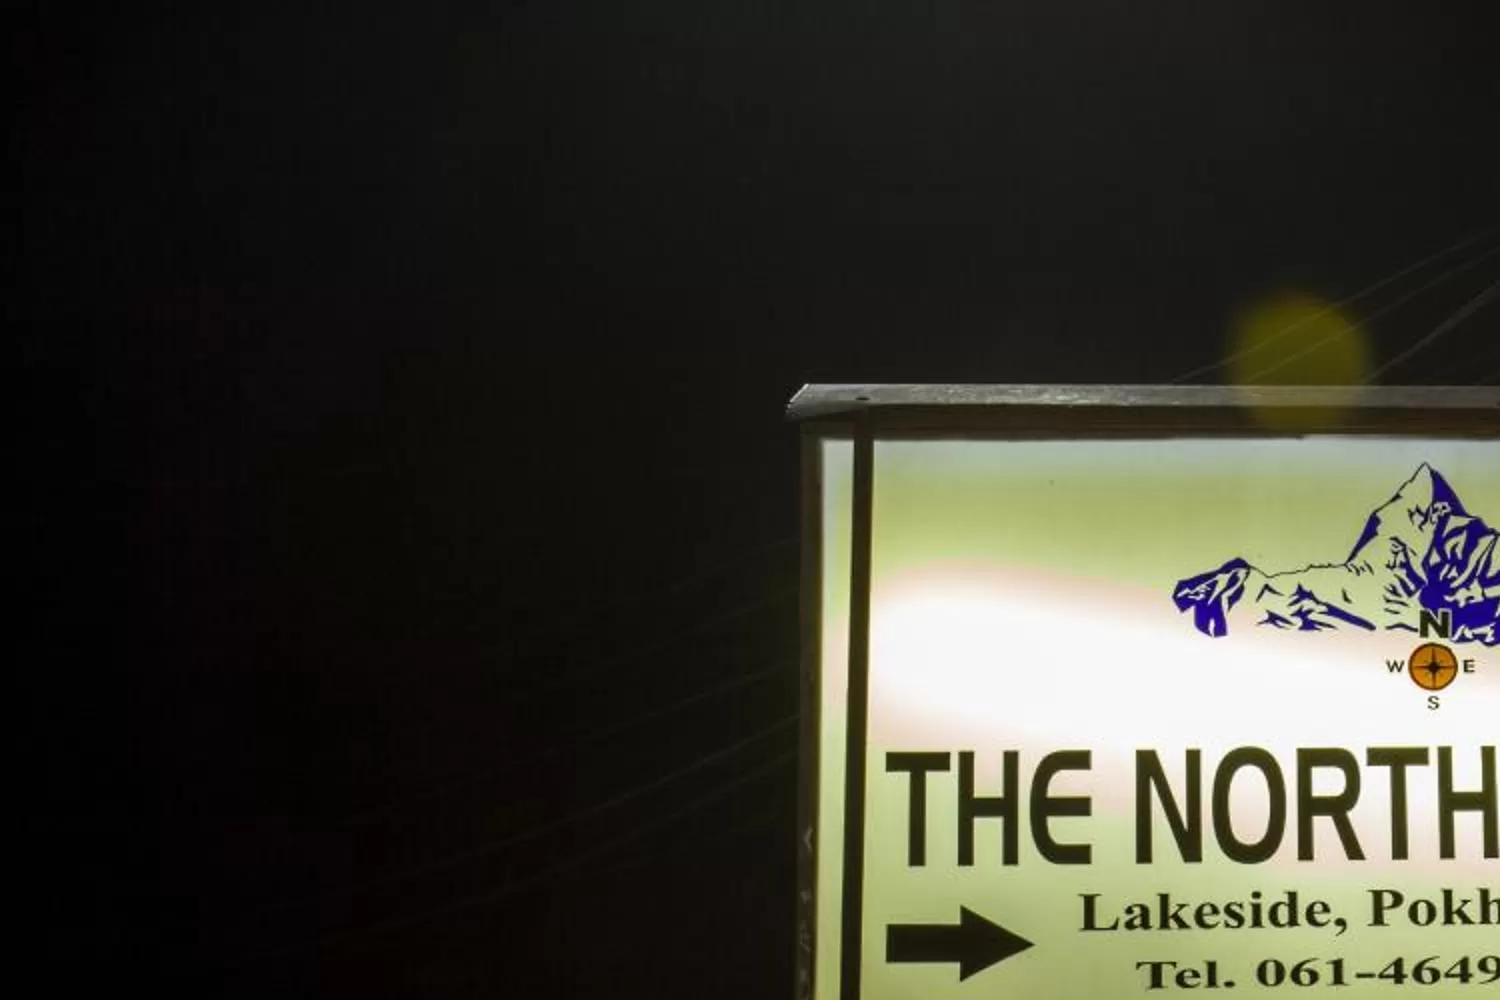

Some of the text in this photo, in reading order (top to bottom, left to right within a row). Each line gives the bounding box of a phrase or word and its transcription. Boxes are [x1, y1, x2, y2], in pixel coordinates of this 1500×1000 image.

[1419, 610, 1450, 638] N
[1386, 659, 1405, 673] W
[1463, 659, 1475, 673] E
[1427, 695, 1440, 710] S
[886, 750, 1092, 867] THE
[1136, 746, 1500, 864] NORTH
[1078, 891, 1348, 936] Lakeside,
[1135, 961, 1236, 990] Tel.
